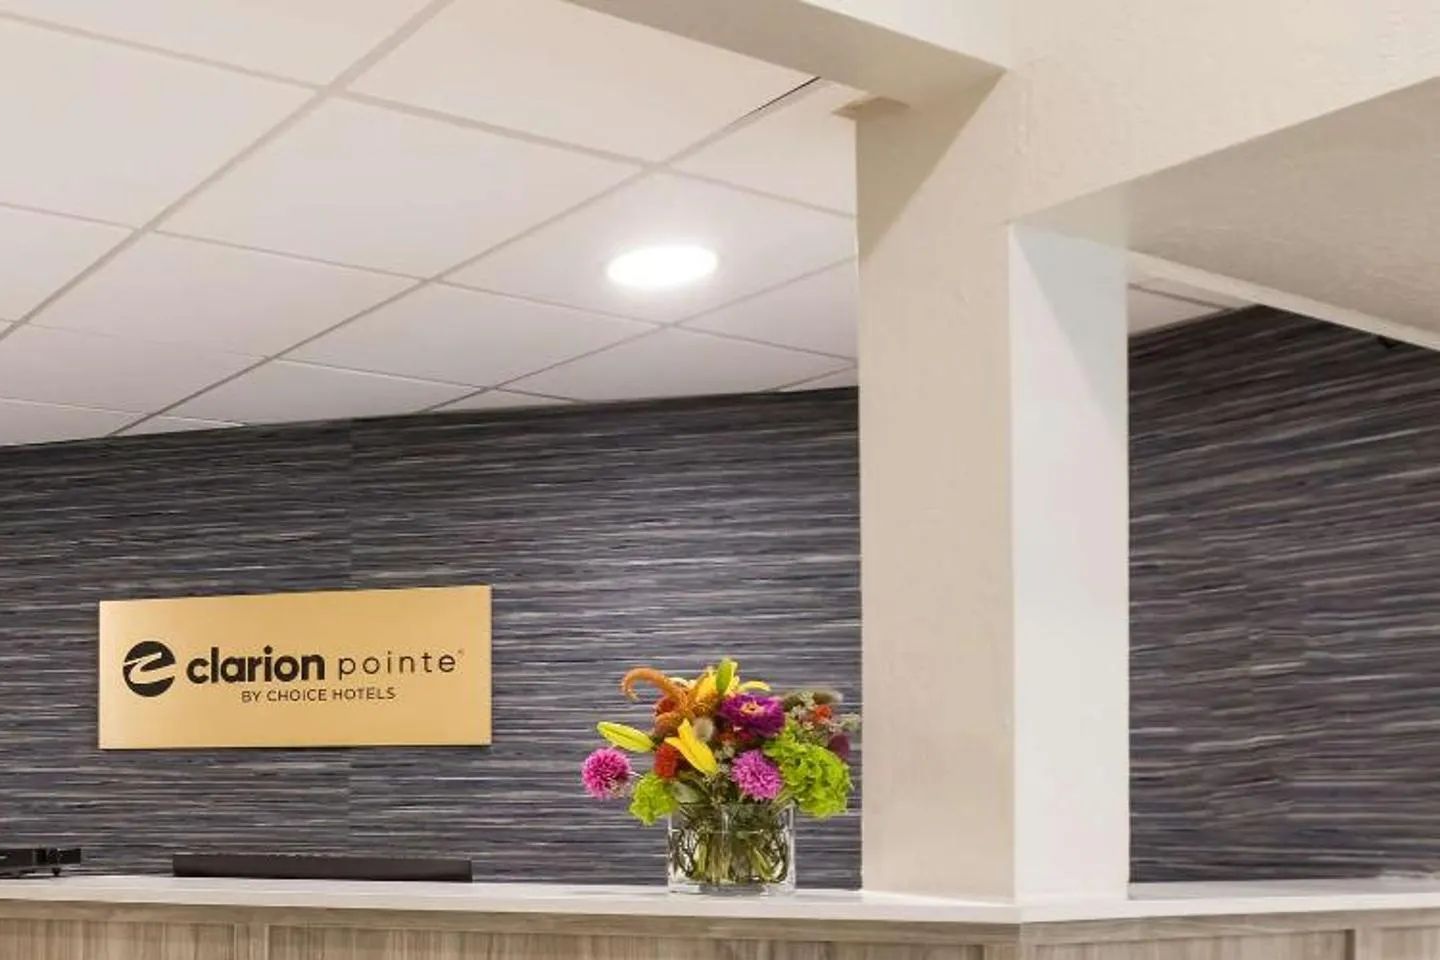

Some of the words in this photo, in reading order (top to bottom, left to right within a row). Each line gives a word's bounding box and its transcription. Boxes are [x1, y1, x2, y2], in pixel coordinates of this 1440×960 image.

[186, 645, 325, 684] clarion
[338, 650, 456, 681] pointe
[241, 690, 261, 703] BY
[266, 688, 327, 702] CHOICE
[331, 686, 397, 701] HOTELS
